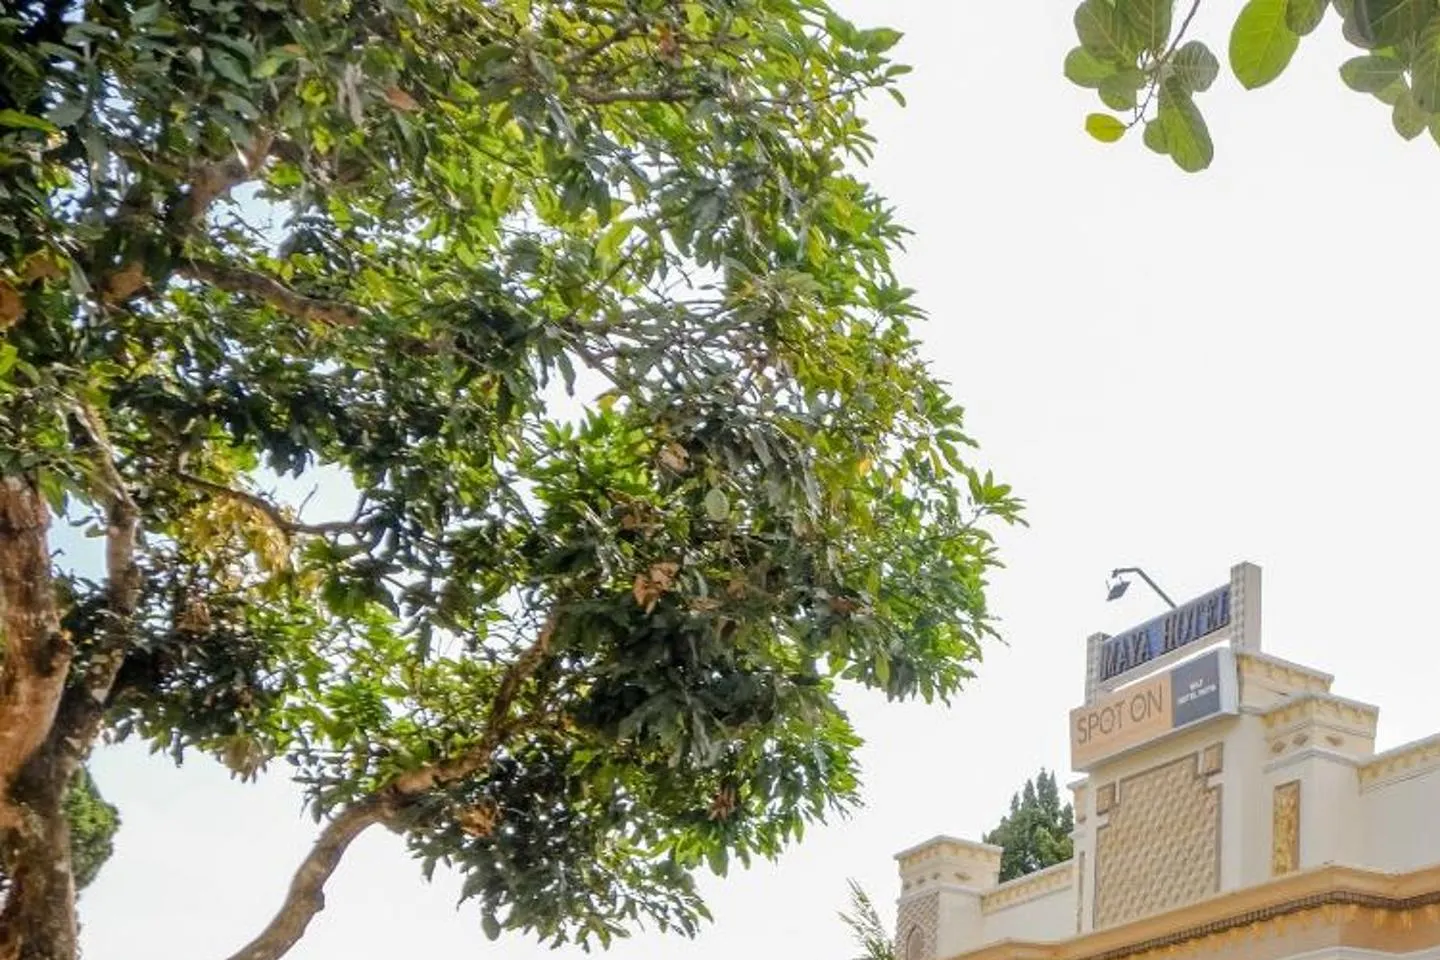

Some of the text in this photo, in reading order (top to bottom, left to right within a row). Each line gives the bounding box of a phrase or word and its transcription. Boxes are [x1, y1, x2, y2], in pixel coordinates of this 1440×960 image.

[1101, 627, 1150, 680] MAYA
[1077, 699, 1125, 744] SPOT
[1130, 682, 1162, 722] ON
